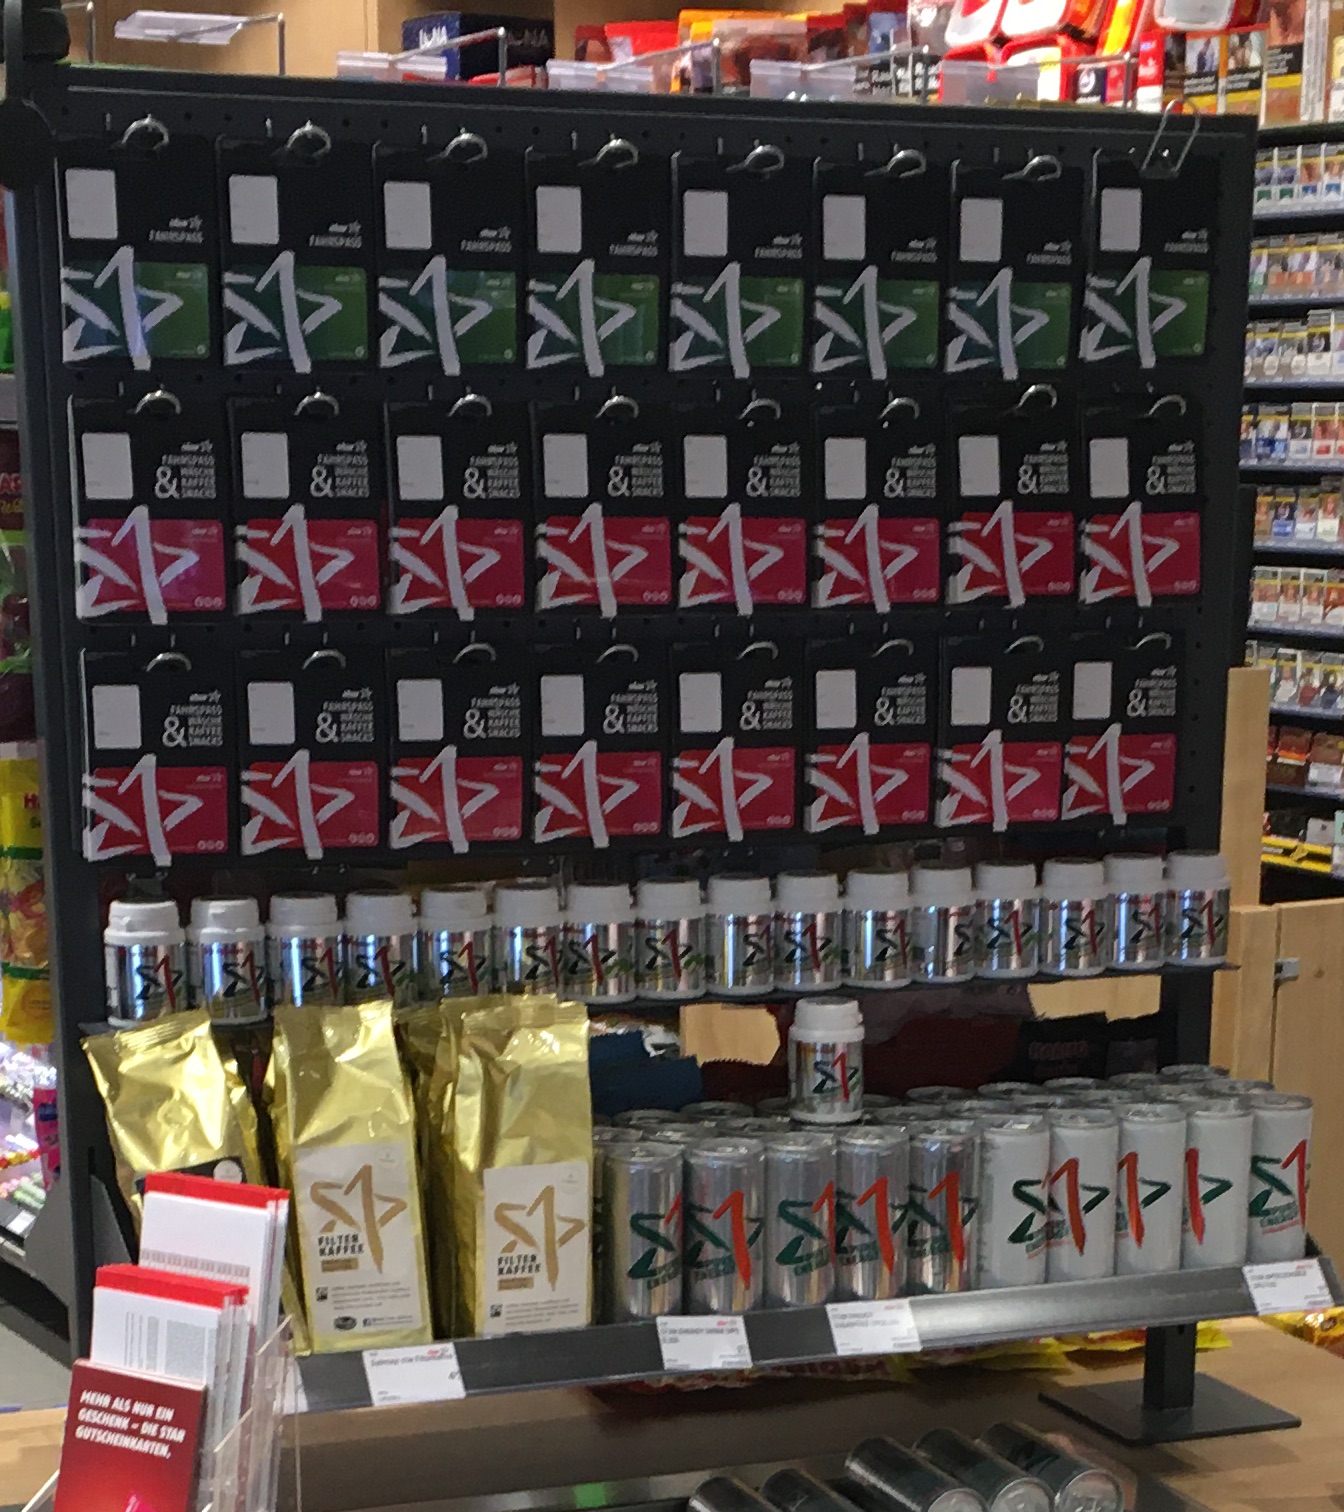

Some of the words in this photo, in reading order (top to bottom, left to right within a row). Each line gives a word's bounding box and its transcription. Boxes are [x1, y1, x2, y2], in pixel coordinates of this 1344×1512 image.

[155, 465, 179, 499] &
[310, 465, 334, 498] &
[463, 467, 486, 498] &
[608, 465, 630, 497] &
[746, 466, 768, 497] &
[884, 467, 905, 498] &
[463, 709, 486, 739] &
[603, 704, 625, 734] &
[740, 701, 761, 730] &
[875, 697, 894, 726] &
[163, 716, 187, 747] &
[315, 712, 338, 742] &
[318, 1234, 360, 1247] FILTER
[319, 1244, 365, 1257] KAFFEE
[497, 1254, 538, 1267] FILTER
[497, 1264, 542, 1277] KAFFEE
[80, 1389, 112, 1408] MEHR
[111, 1397, 131, 1413] ALS
[132, 1400, 155, 1418] NUR
[155, 1406, 175, 1422] EIN
[77, 1408, 130, 1430] GESCHENK
[140, 1421, 159, 1437] DIE
[159, 1426, 187, 1444] STAR
